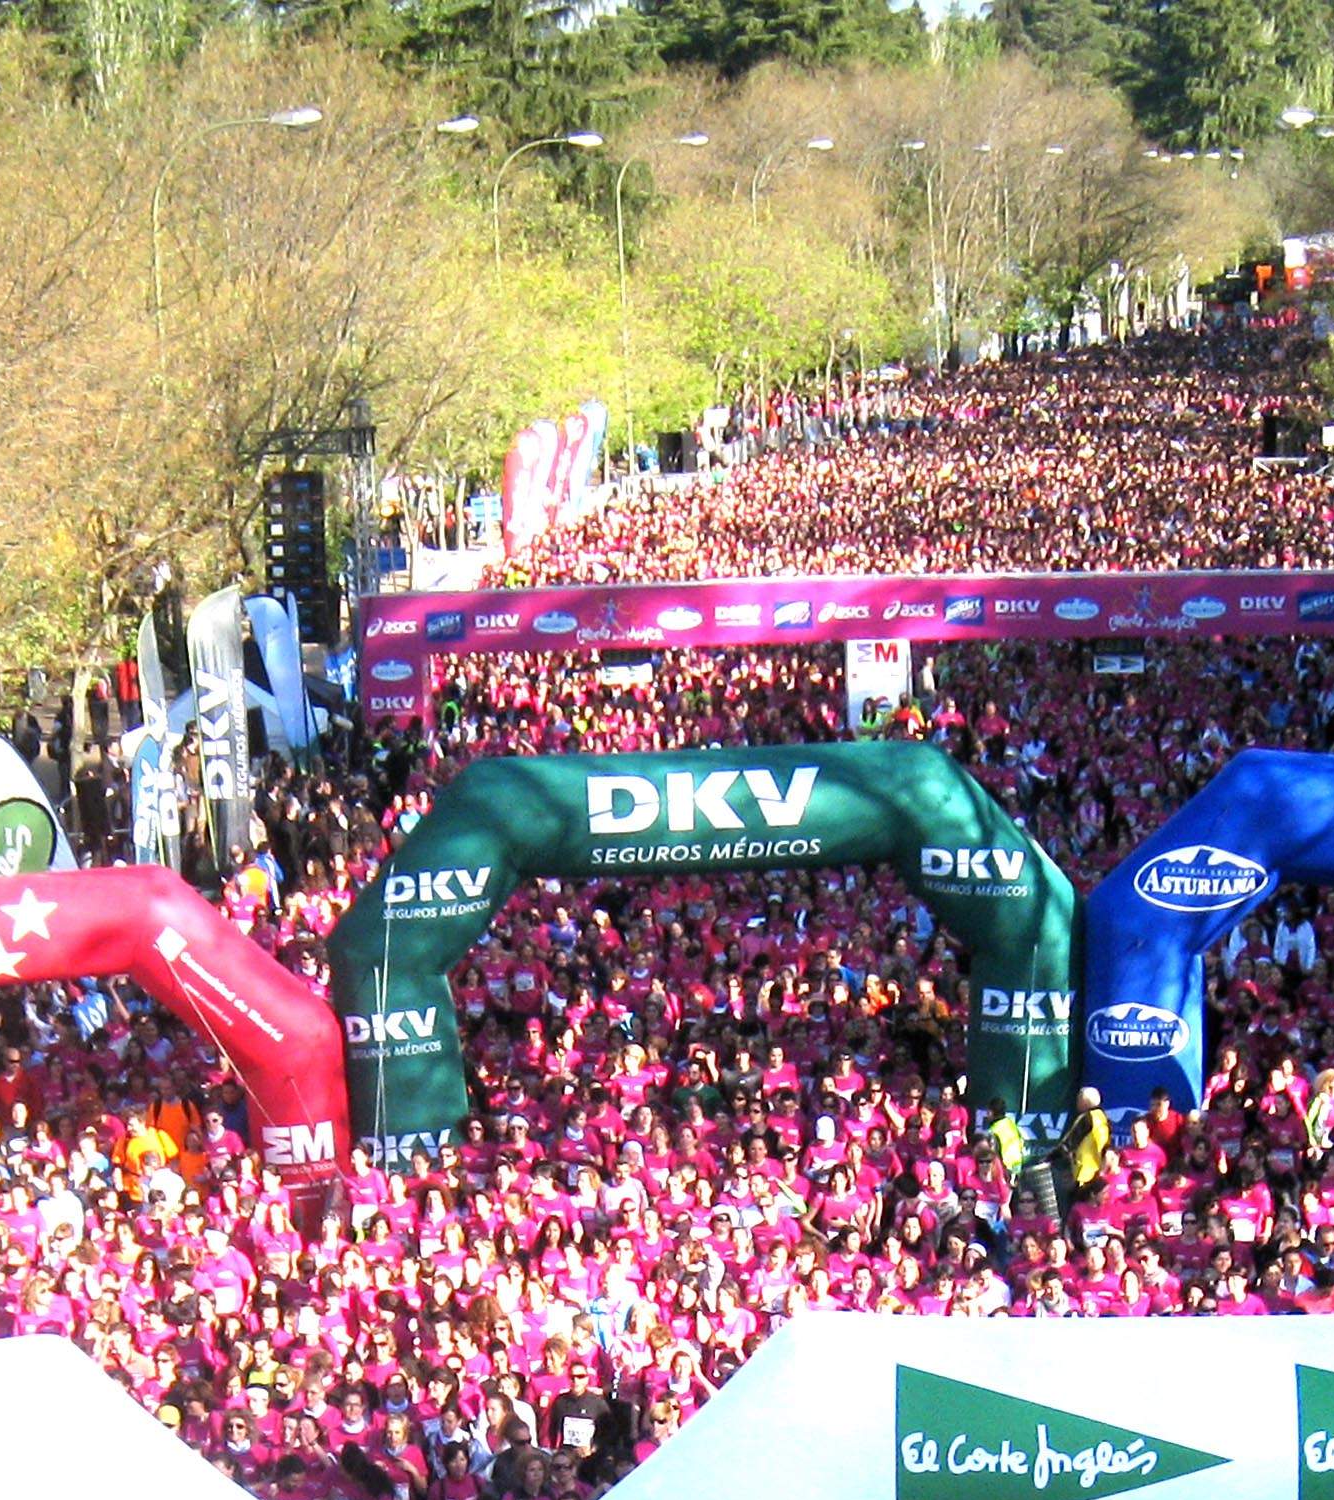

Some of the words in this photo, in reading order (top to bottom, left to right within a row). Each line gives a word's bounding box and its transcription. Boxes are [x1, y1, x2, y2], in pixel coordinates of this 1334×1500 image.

[901, 603, 935, 617] asics
[995, 601, 1040, 613] DKV
[1240, 597, 1285, 609] DKV
[383, 621, 416, 633] asics
[475, 614, 519, 628] DKV
[371, 697, 415, 709] DKV
[196, 668, 233, 800] DKV
[587, 766, 819, 834] DKV
[591, 844, 701, 864] SEGUROS
[709, 837, 821, 862] MÉDICOS
[921, 847, 1025, 880] DKV
[384, 866, 491, 904] DKV
[1142, 867, 1257, 896] ASTURIANA
[382, 906, 437, 921] SEGUROS
[440, 898, 491, 918] MÉDICOS
[981, 988, 1076, 1019] DKV
[345, 1006, 436, 1043] DKV
[1092, 1026, 1181, 1049] ASTURIANA
[901, 1433, 939, 1473] El
[949, 1438, 1030, 1477] Corte
[1033, 1424, 1158, 1489] Inglés
